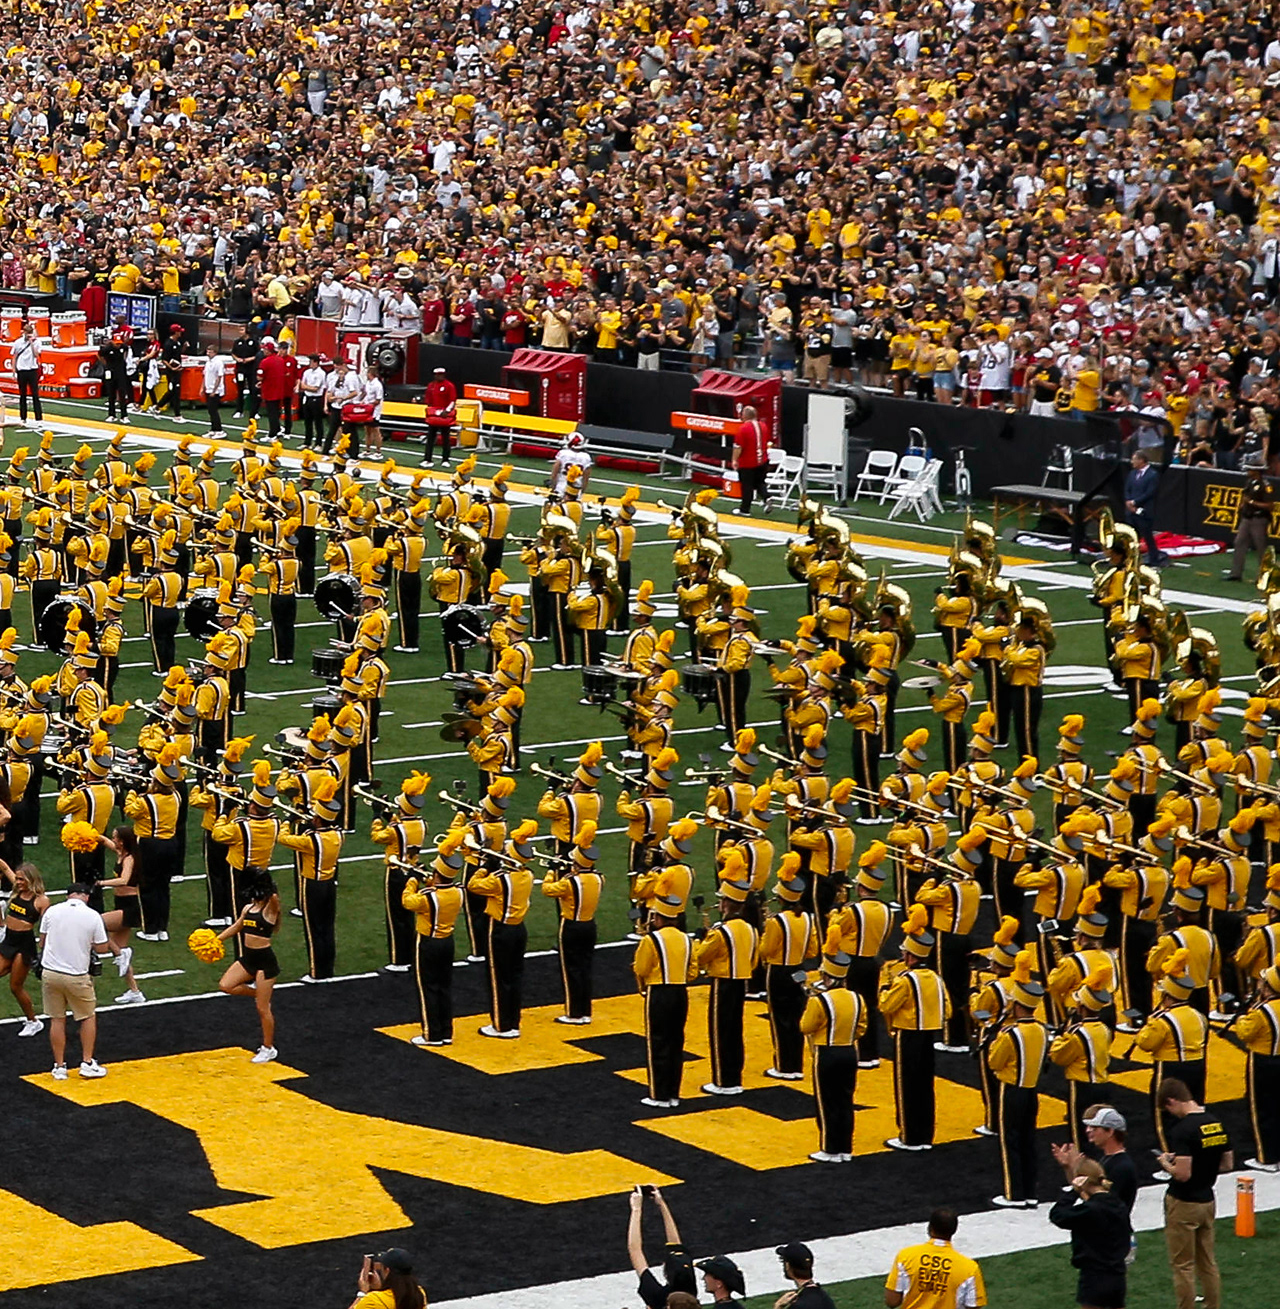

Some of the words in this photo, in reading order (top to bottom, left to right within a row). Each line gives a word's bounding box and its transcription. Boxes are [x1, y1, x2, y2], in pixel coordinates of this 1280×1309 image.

[79, 361, 90, 377] G
[88, 386, 96, 396] G
[1203, 484, 1243, 509] FIG
[920, 1254, 951, 1270] CSC
[918, 1268, 950, 1283] EVENT
[918, 1281, 948, 1296] STAFF
